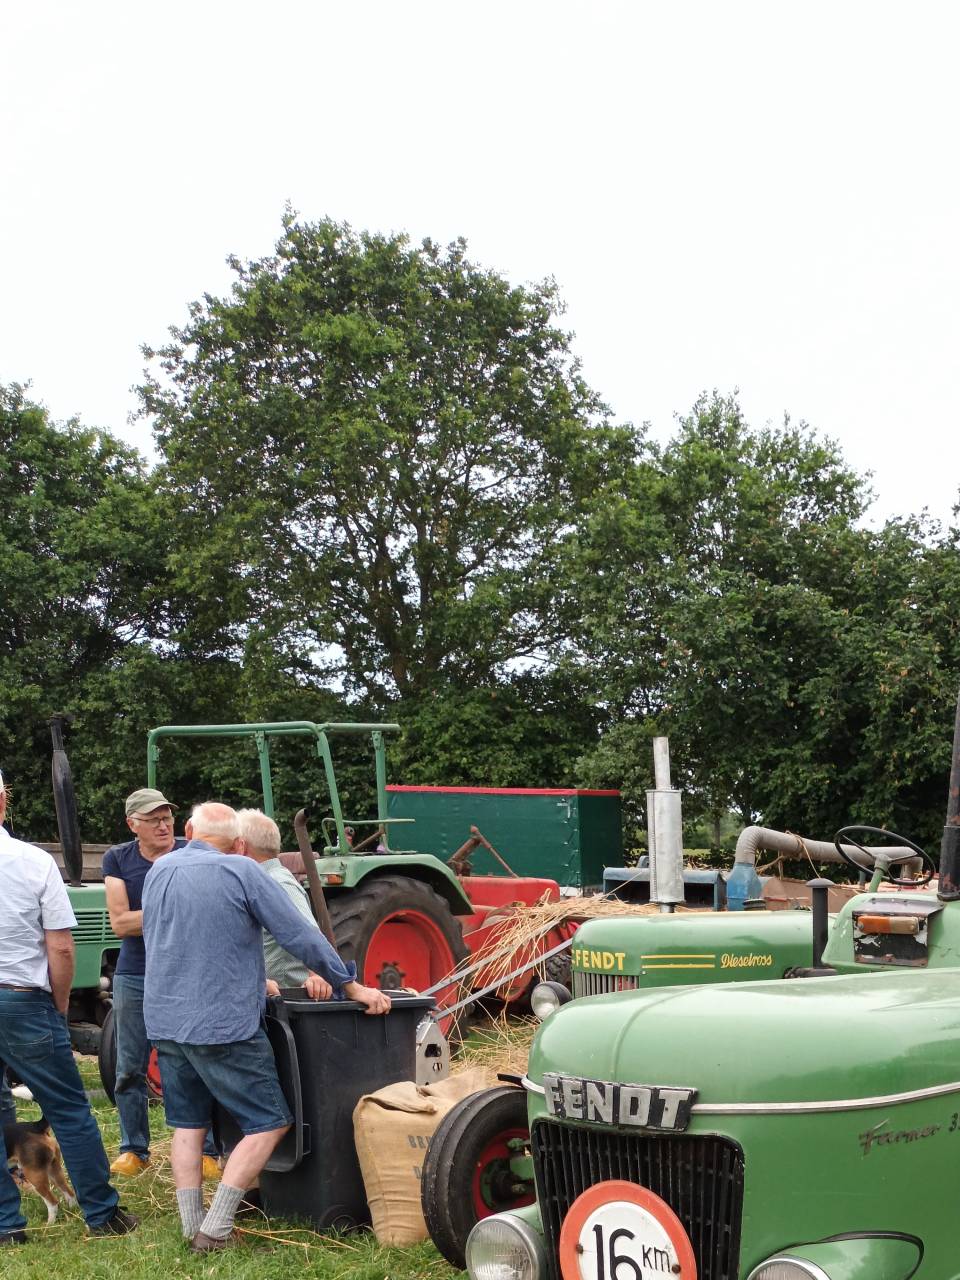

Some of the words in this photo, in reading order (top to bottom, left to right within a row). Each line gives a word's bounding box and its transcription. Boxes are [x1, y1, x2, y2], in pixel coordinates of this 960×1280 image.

[575, 950, 625, 970] FENDT
[721, 953, 772, 968] Dieselross
[544, 1076, 690, 1128] FENDT
[859, 1118, 940, 1156] Farmer
